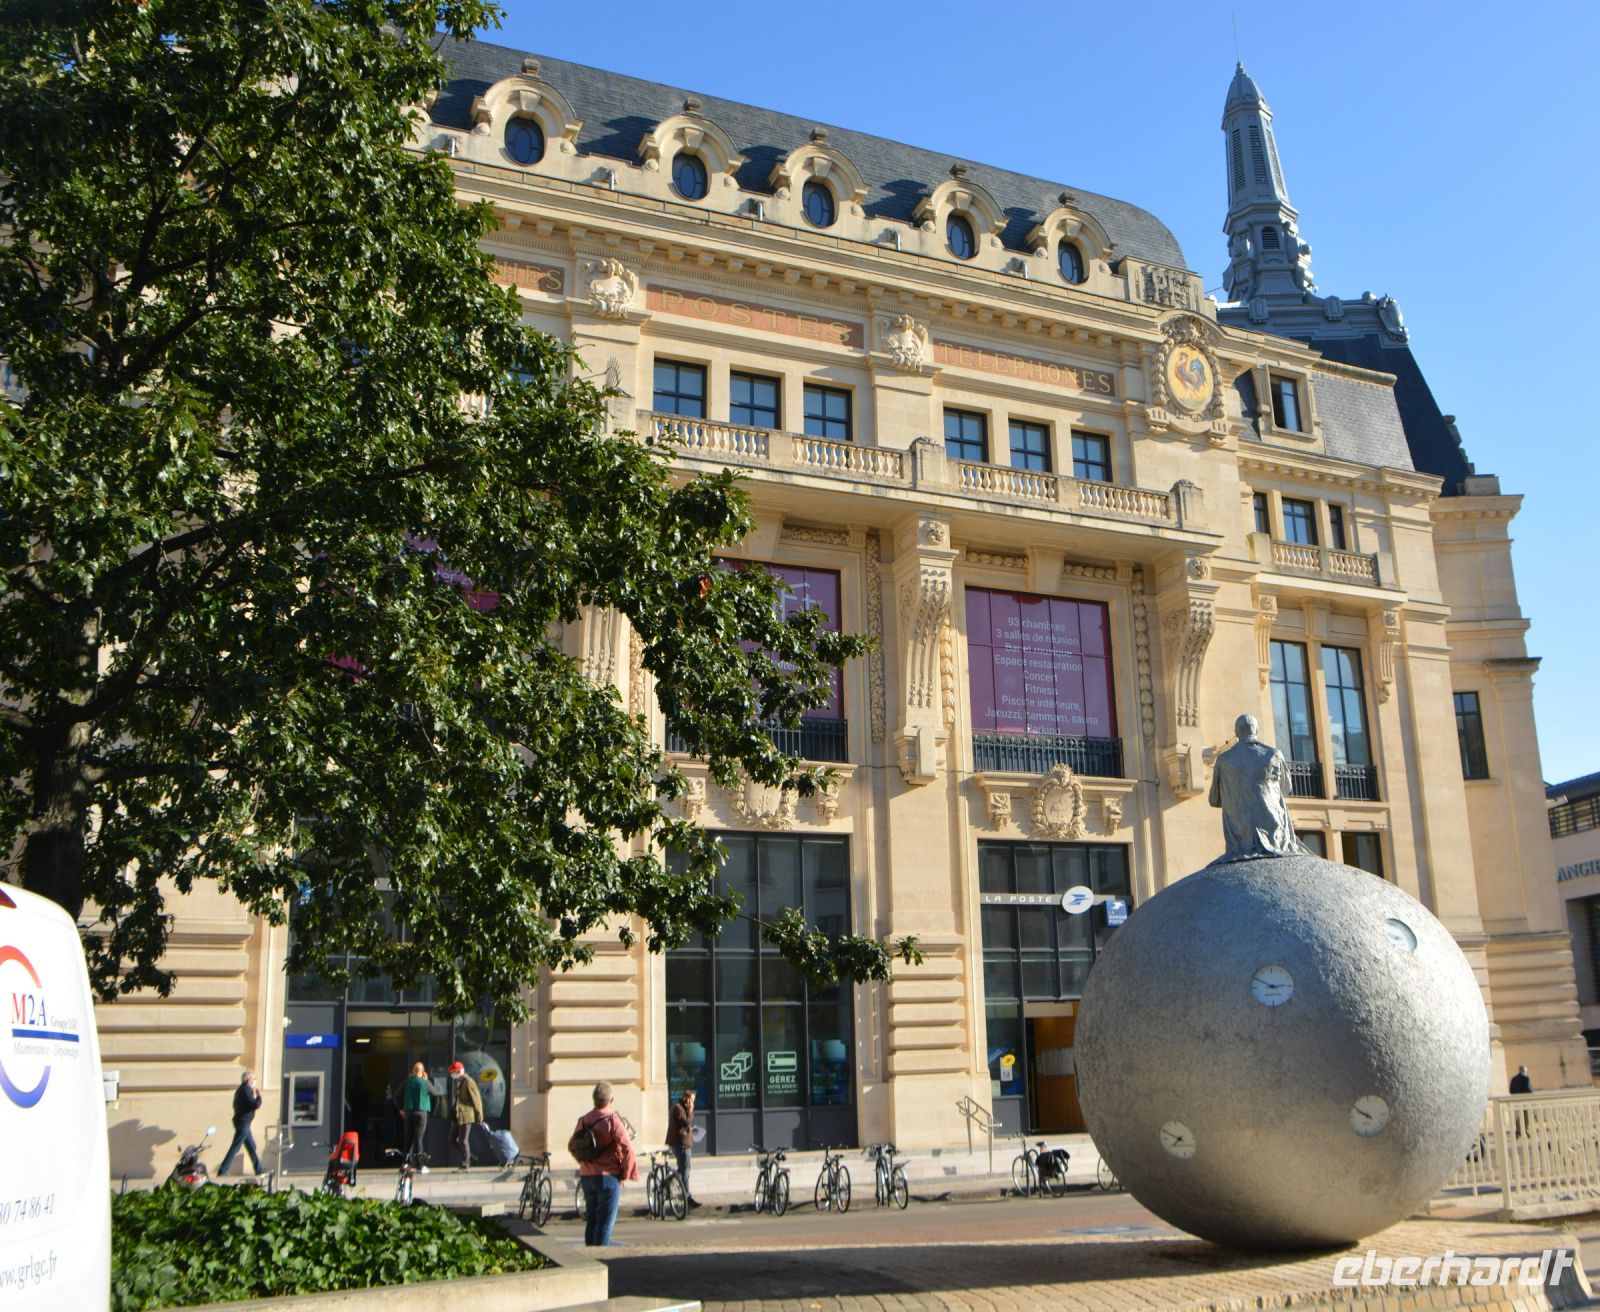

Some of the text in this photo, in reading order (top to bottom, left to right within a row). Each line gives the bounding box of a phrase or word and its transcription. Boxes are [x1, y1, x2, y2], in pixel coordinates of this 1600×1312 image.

[495, 261, 562, 290] HES
[661, 289, 852, 343] POSTES
[939, 342, 1111, 393] TELEPHONES
[1008, 617, 1020, 627] 93
[996, 629, 1002, 638] 3
[1032, 632, 1044, 642] de
[1029, 658, 1083, 671] restauration
[1024, 670, 1058, 682] Concert
[1025, 683, 1058, 695] Fitness
[985, 895, 1052, 903] LA POSTE
[11, 992, 47, 1026] M2A
[769, 1074, 796, 1083] GÉREZ
[719, 1083, 756, 1093] ENVOYEZ
[14, 1199, 29, 1223] 74
[29, 1194, 42, 1219] 86
